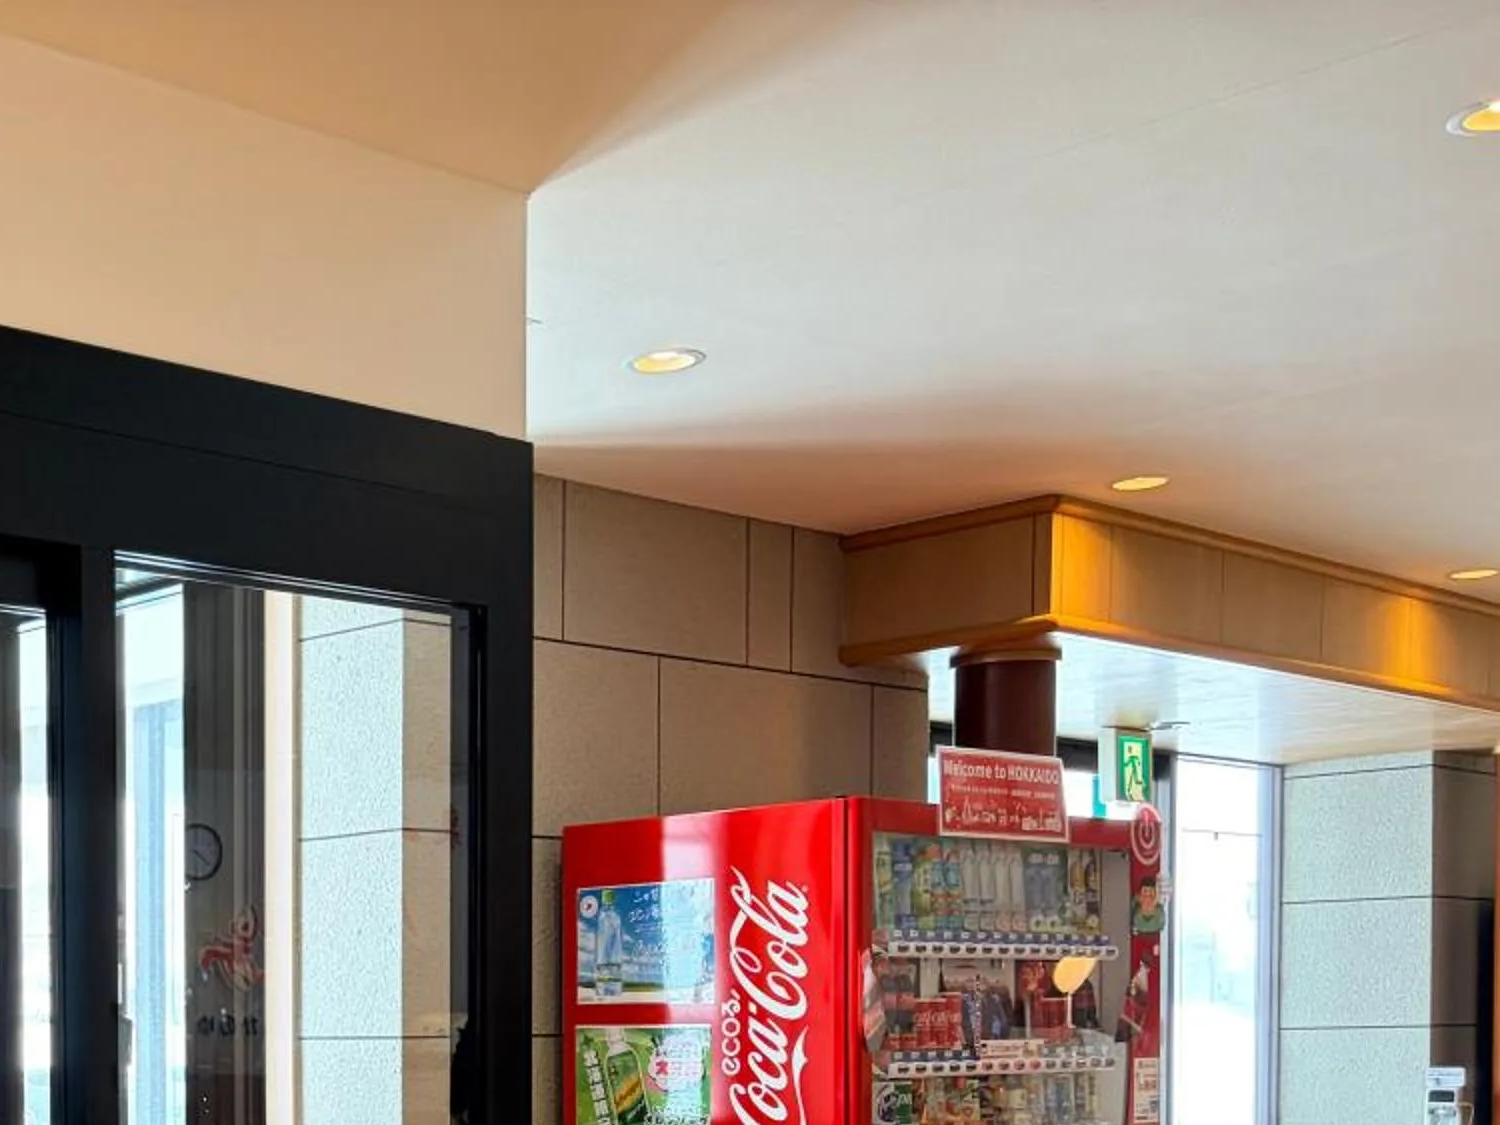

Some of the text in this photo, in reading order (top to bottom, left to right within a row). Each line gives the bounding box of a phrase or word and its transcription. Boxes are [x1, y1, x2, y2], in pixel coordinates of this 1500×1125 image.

[943, 759, 1060, 785] Welcome to HOKKAIDO
